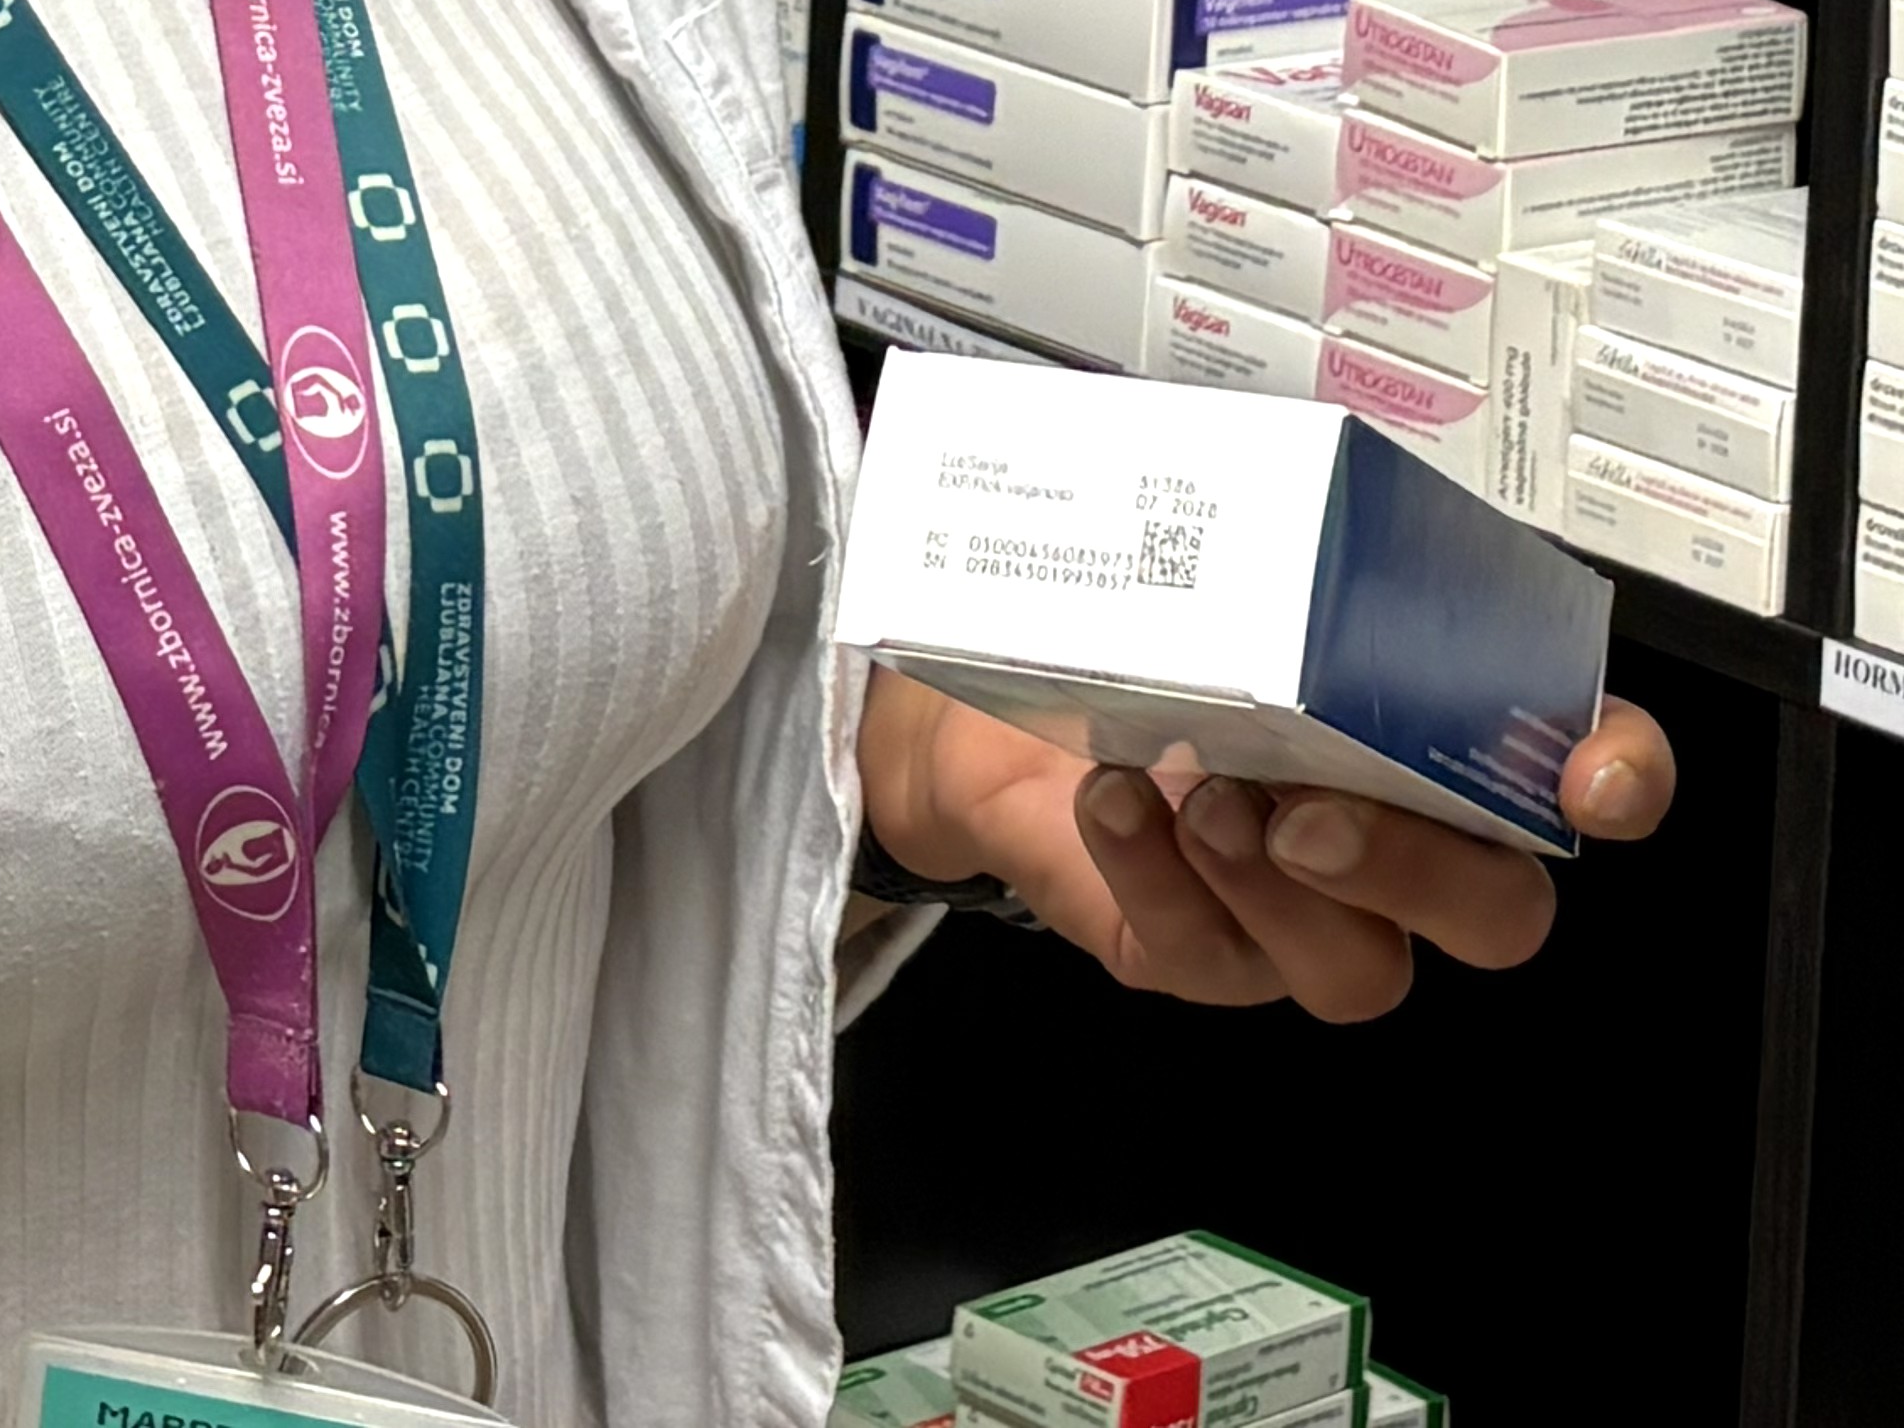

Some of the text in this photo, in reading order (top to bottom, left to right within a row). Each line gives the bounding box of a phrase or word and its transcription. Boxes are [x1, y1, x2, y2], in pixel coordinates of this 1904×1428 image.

[43, 408, 229, 761] www.zbornica-zveza.si
[432, 582, 456, 720] LJUBLJANA
[440, 582, 473, 815] ZDRAVSTVENI DOM
